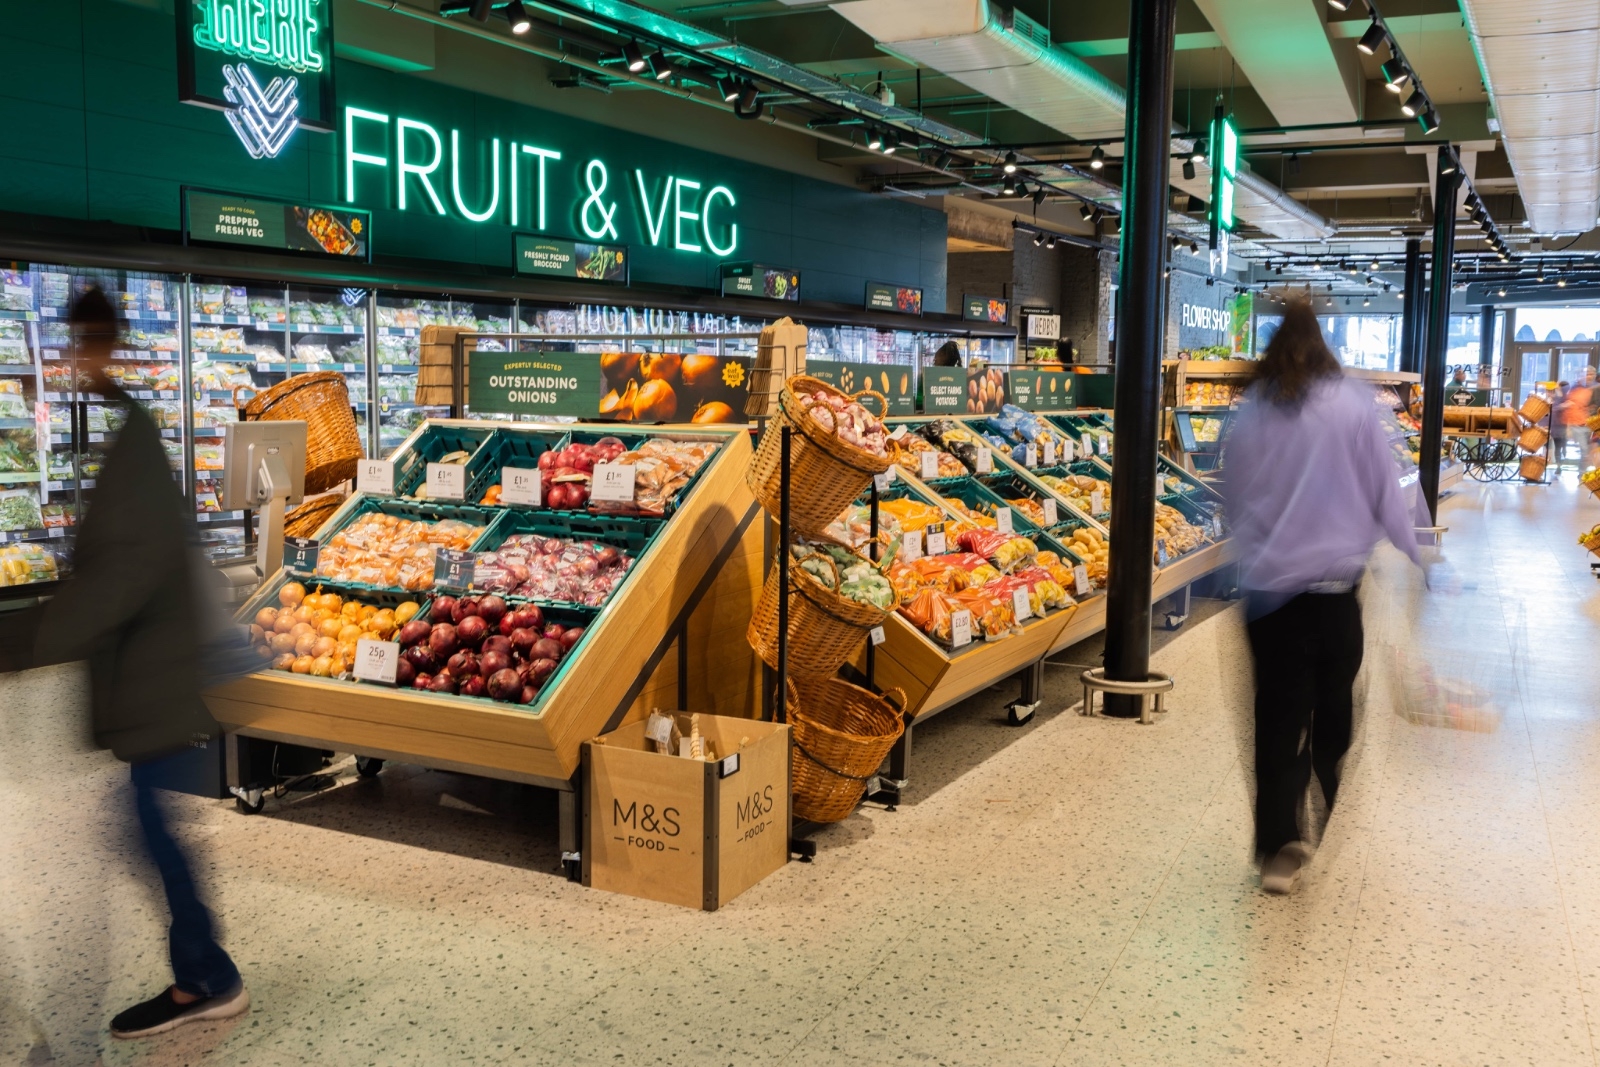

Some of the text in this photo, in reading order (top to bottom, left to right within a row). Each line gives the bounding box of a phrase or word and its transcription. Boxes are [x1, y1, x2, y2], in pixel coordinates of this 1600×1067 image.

[345, 105, 738, 257] FRUIT & VEG
[219, 214, 260, 227] PREPPED
[215, 224, 264, 238] FRESH VEG
[524, 250, 570, 262] FRESHLY PICKED
[533, 260, 562, 269] BROCCOLI
[1182, 303, 1231, 332] FLOWER SHOP
[1034, 316, 1054, 336] HERBS
[504, 362, 562, 372] EXPERTLY SELECTED
[489, 375, 578, 390] OUTSTANDING
[508, 390, 557, 404] ONIONS
[930, 386, 962, 395] SELECT FARMS
[935, 397, 958, 406] POTATOES
[296, 550, 306, 560] £1
[450, 564, 460, 574] £1
[369, 646, 385, 659] 25p
[736, 784, 773, 830] M&S
[614, 798, 680, 836] M&S
[744, 822, 765, 842] FOOD
[628, 835, 665, 852] FOOD
